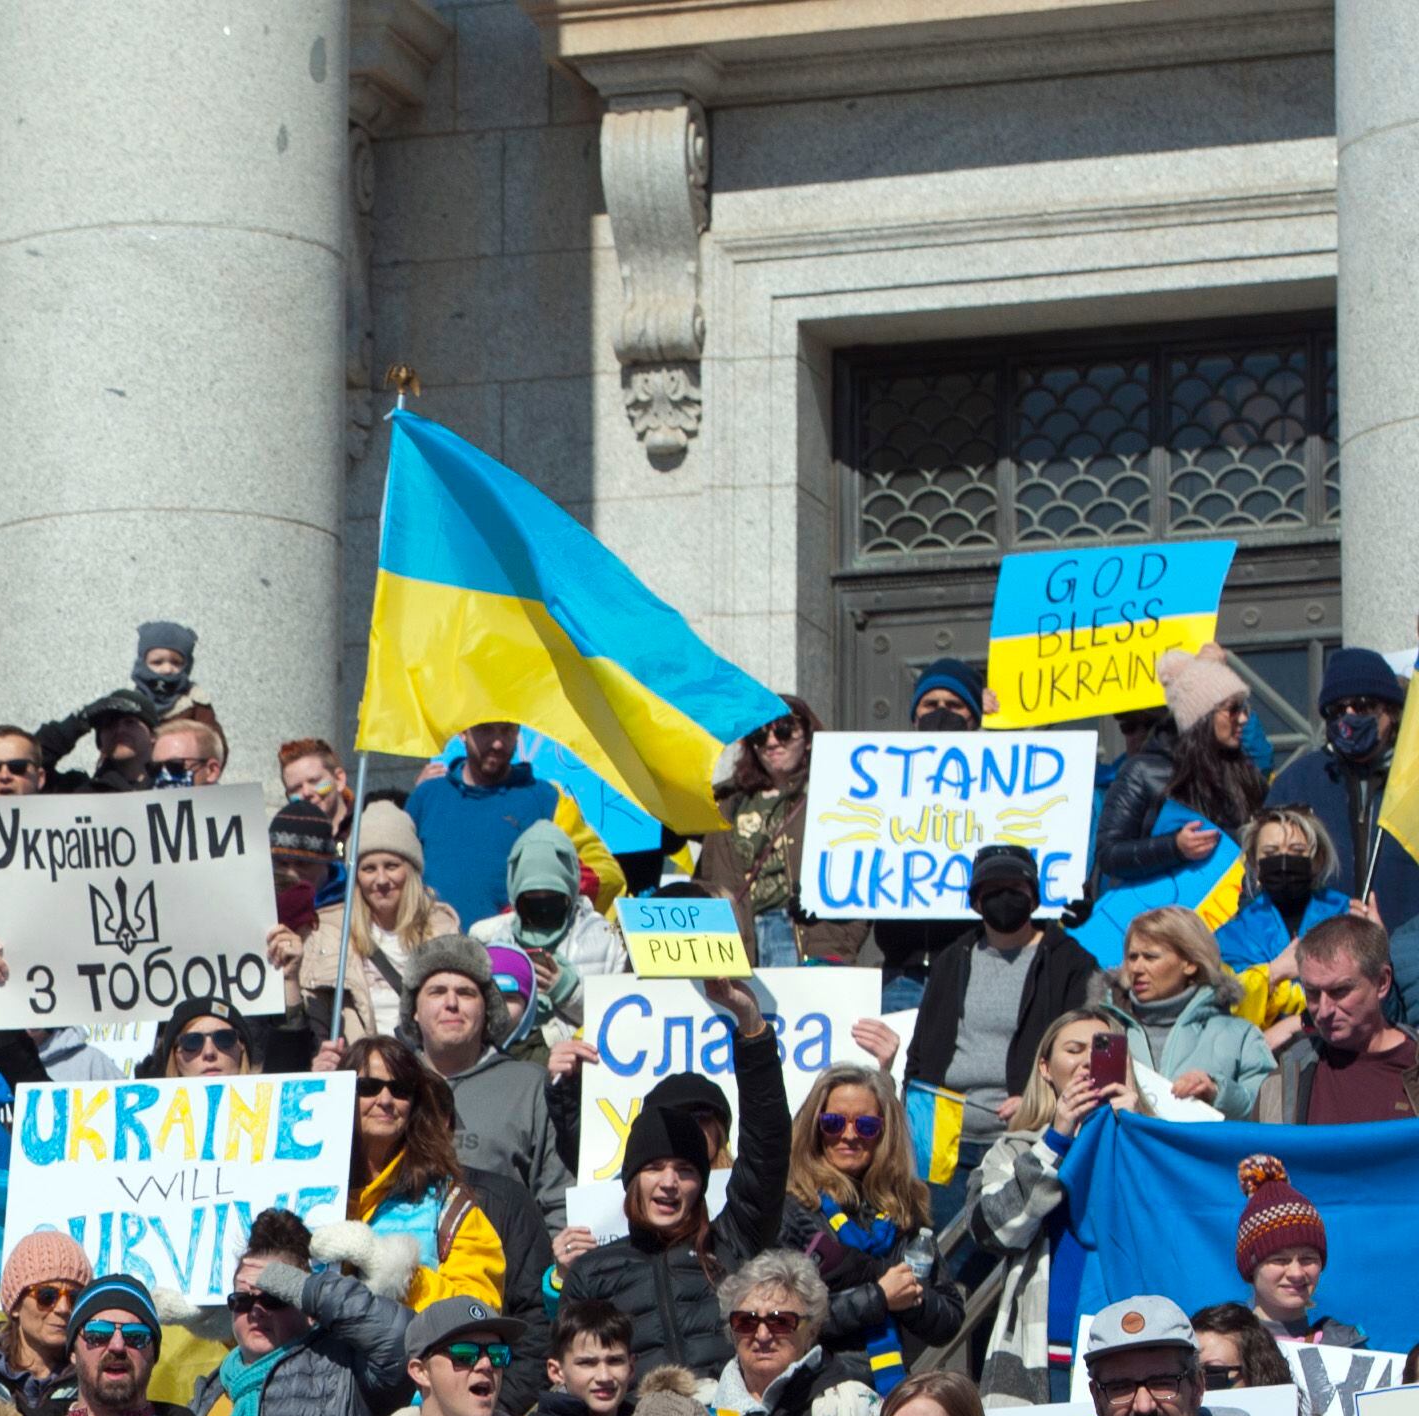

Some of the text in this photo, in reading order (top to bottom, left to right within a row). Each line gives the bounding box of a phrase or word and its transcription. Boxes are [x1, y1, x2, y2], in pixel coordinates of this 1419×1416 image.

[1046, 551, 1168, 605] GOD
[1037, 597, 1164, 660] BLESS
[848, 743, 1066, 801] STAND
[145, 799, 246, 866] Ми
[639, 904, 701, 930] STOP
[20, 1078, 328, 1167] UKRAINE
[116, 1166, 235, 1204] WILL
